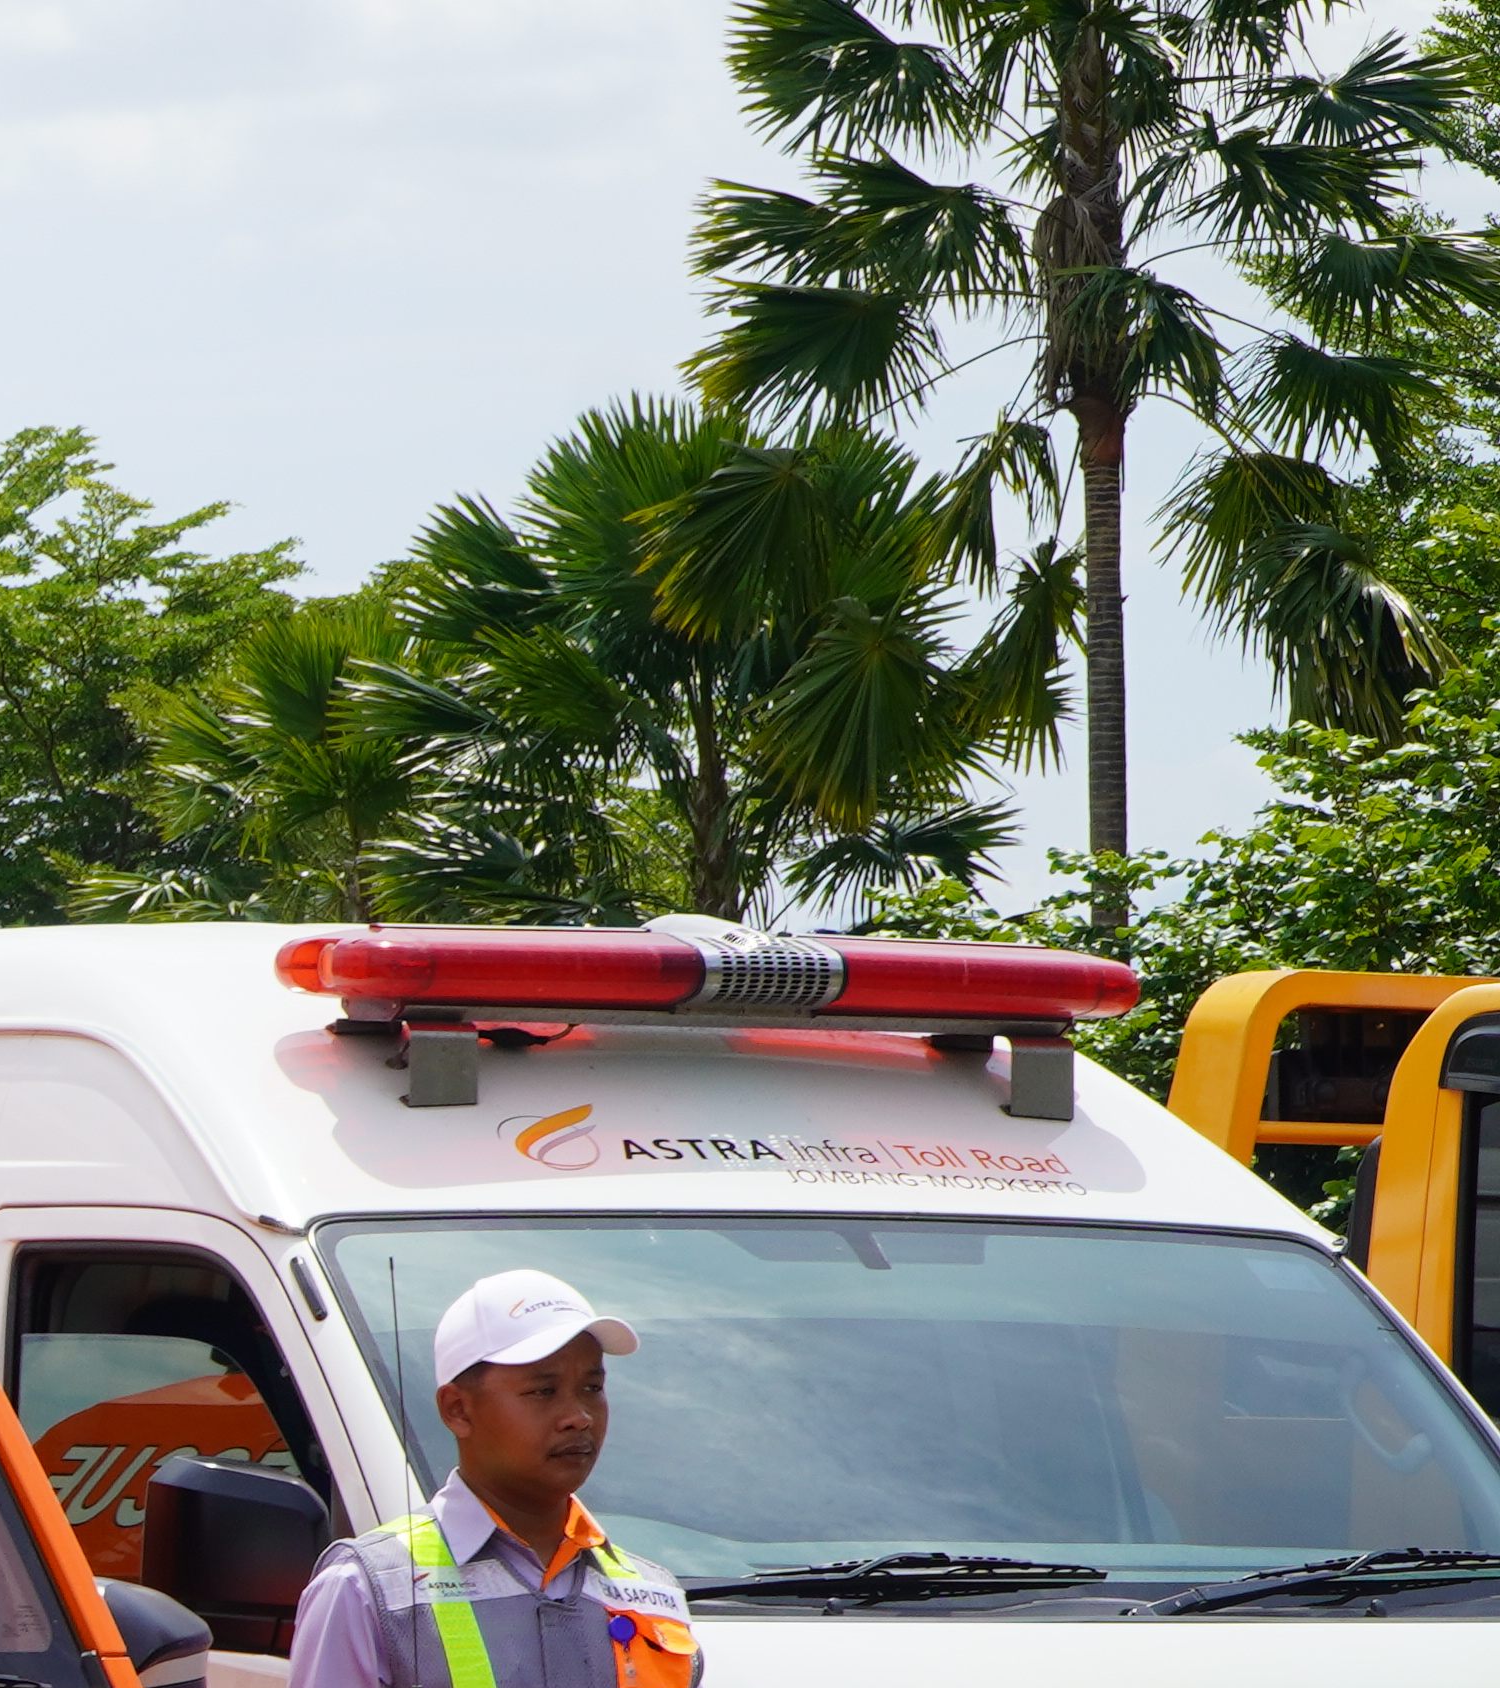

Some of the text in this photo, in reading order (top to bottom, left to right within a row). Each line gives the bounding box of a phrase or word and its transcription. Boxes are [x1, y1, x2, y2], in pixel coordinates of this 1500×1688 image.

[622, 1137, 1072, 1176] ASTRA Infra Toll Road
[789, 1168, 1088, 1197] JOMBANG-MOJOKERTO
[624, 1587, 679, 1612] SAPUTRA
